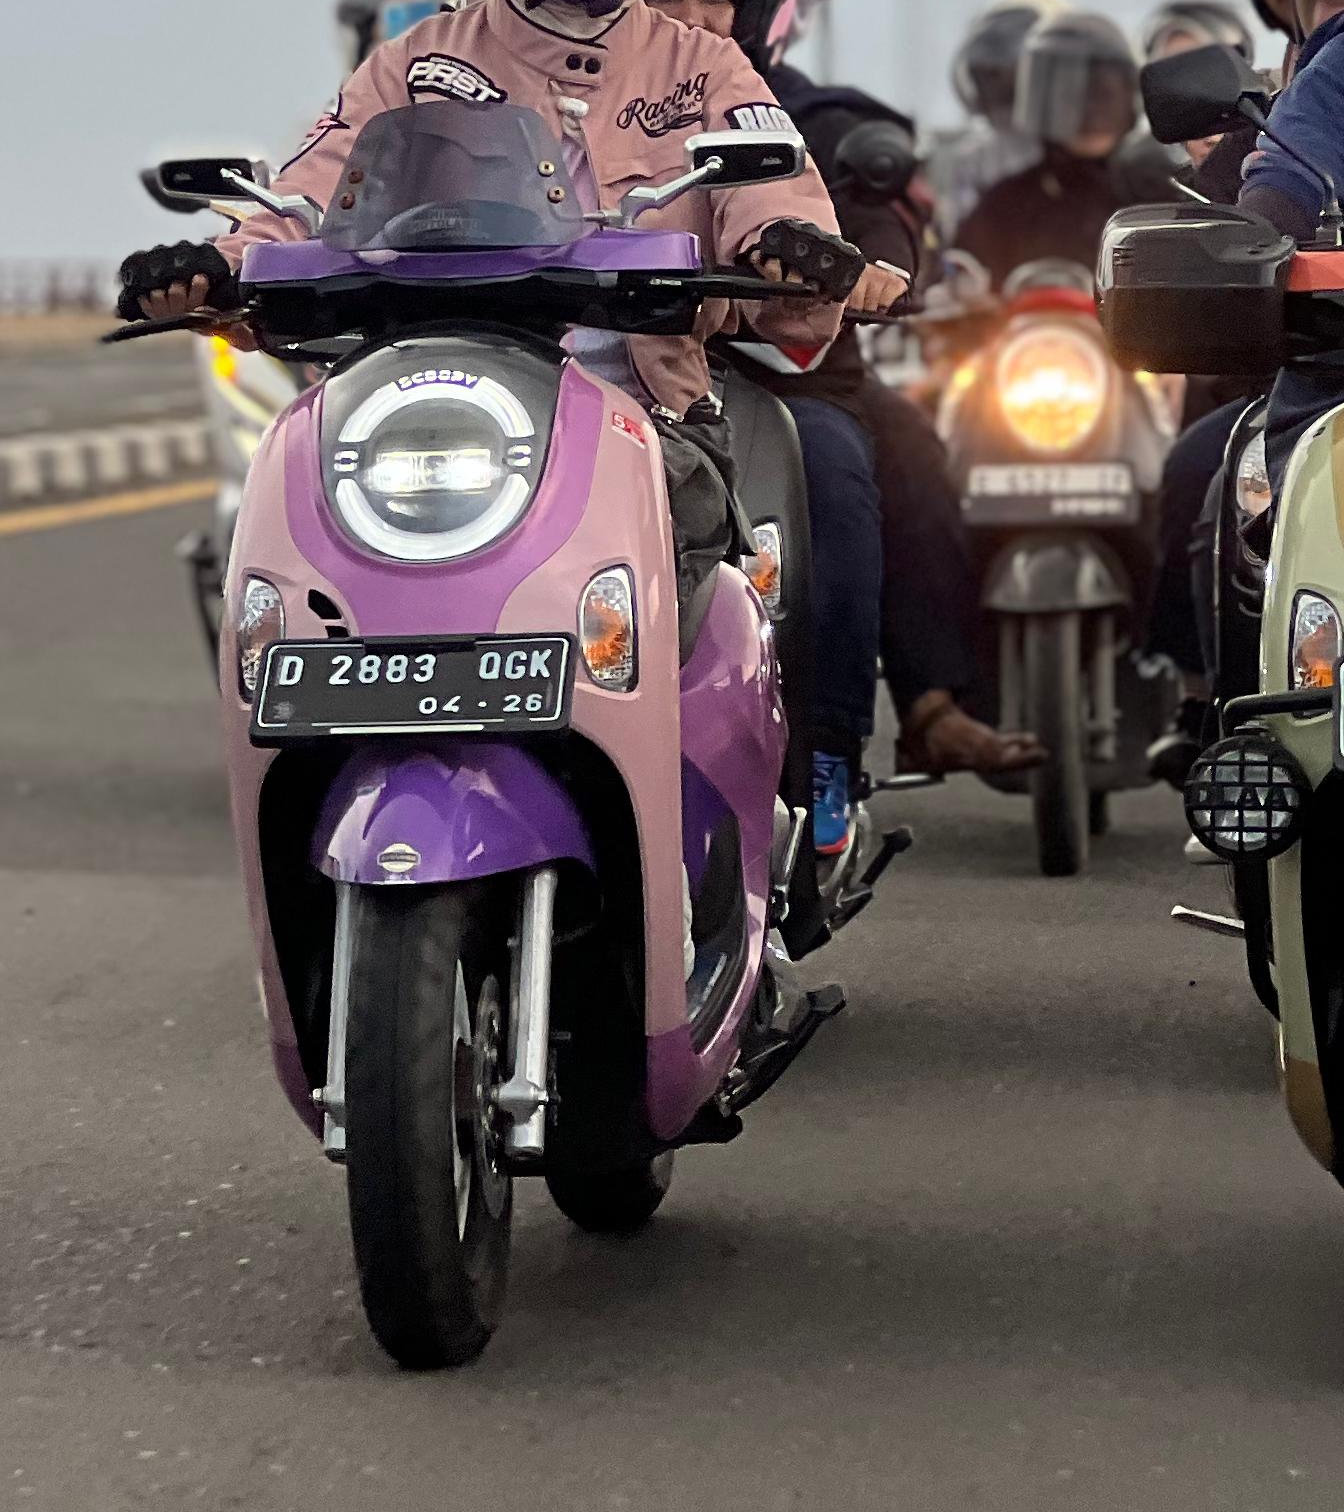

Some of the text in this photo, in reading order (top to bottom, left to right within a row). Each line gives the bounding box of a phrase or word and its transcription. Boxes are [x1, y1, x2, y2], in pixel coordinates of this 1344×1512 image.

[617, 72, 710, 138] Racing
[398, 369, 478, 389] SCOOPY
[278, 649, 553, 687] D 2883 QGK
[417, 695, 462, 715] 04
[502, 693, 544, 713] 26
